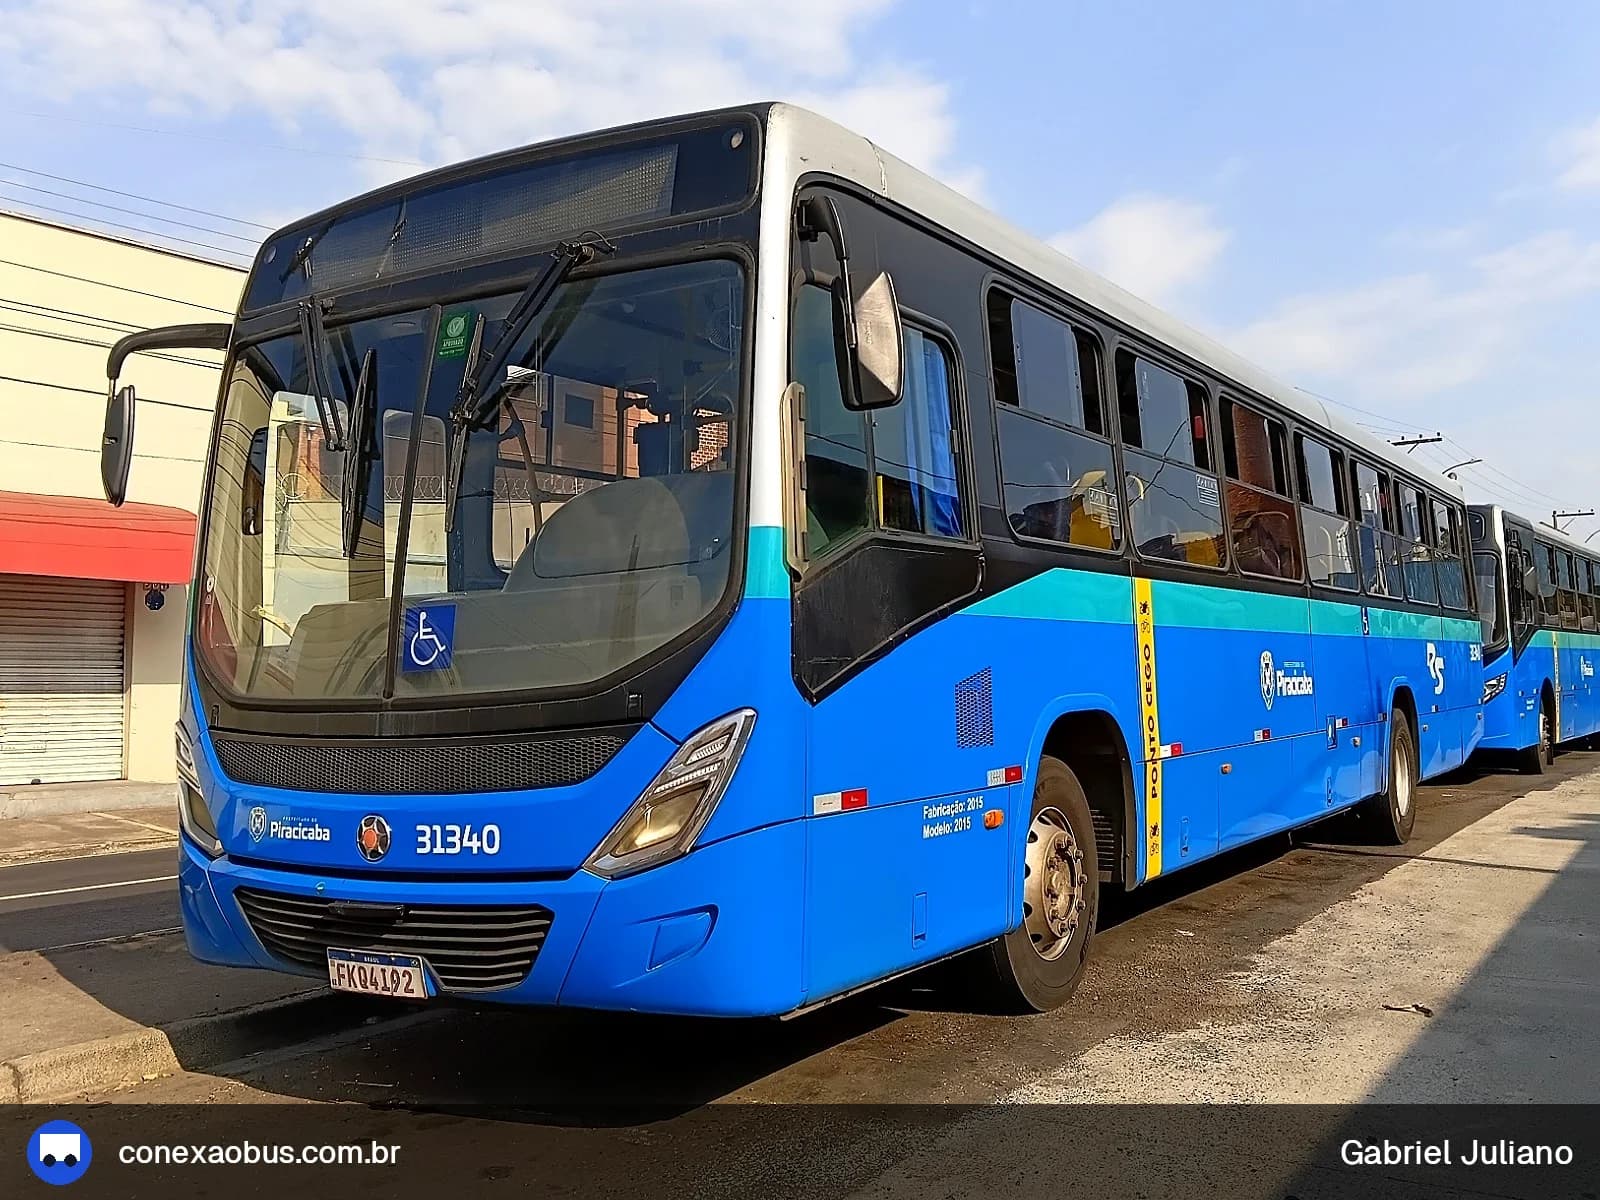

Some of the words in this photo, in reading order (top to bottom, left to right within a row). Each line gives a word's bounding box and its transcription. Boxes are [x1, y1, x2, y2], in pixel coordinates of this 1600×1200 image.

[1143, 643, 1153, 707] CEGO
[1147, 714, 1158, 799] PONTO
[923, 800, 966, 820] Fabricação:
[967, 795, 984, 811] 2015
[270, 820, 331, 841] Piracicaba
[415, 824, 501, 855] 31340
[922, 821, 953, 839] Modelo:
[954, 816, 971, 833] 2015
